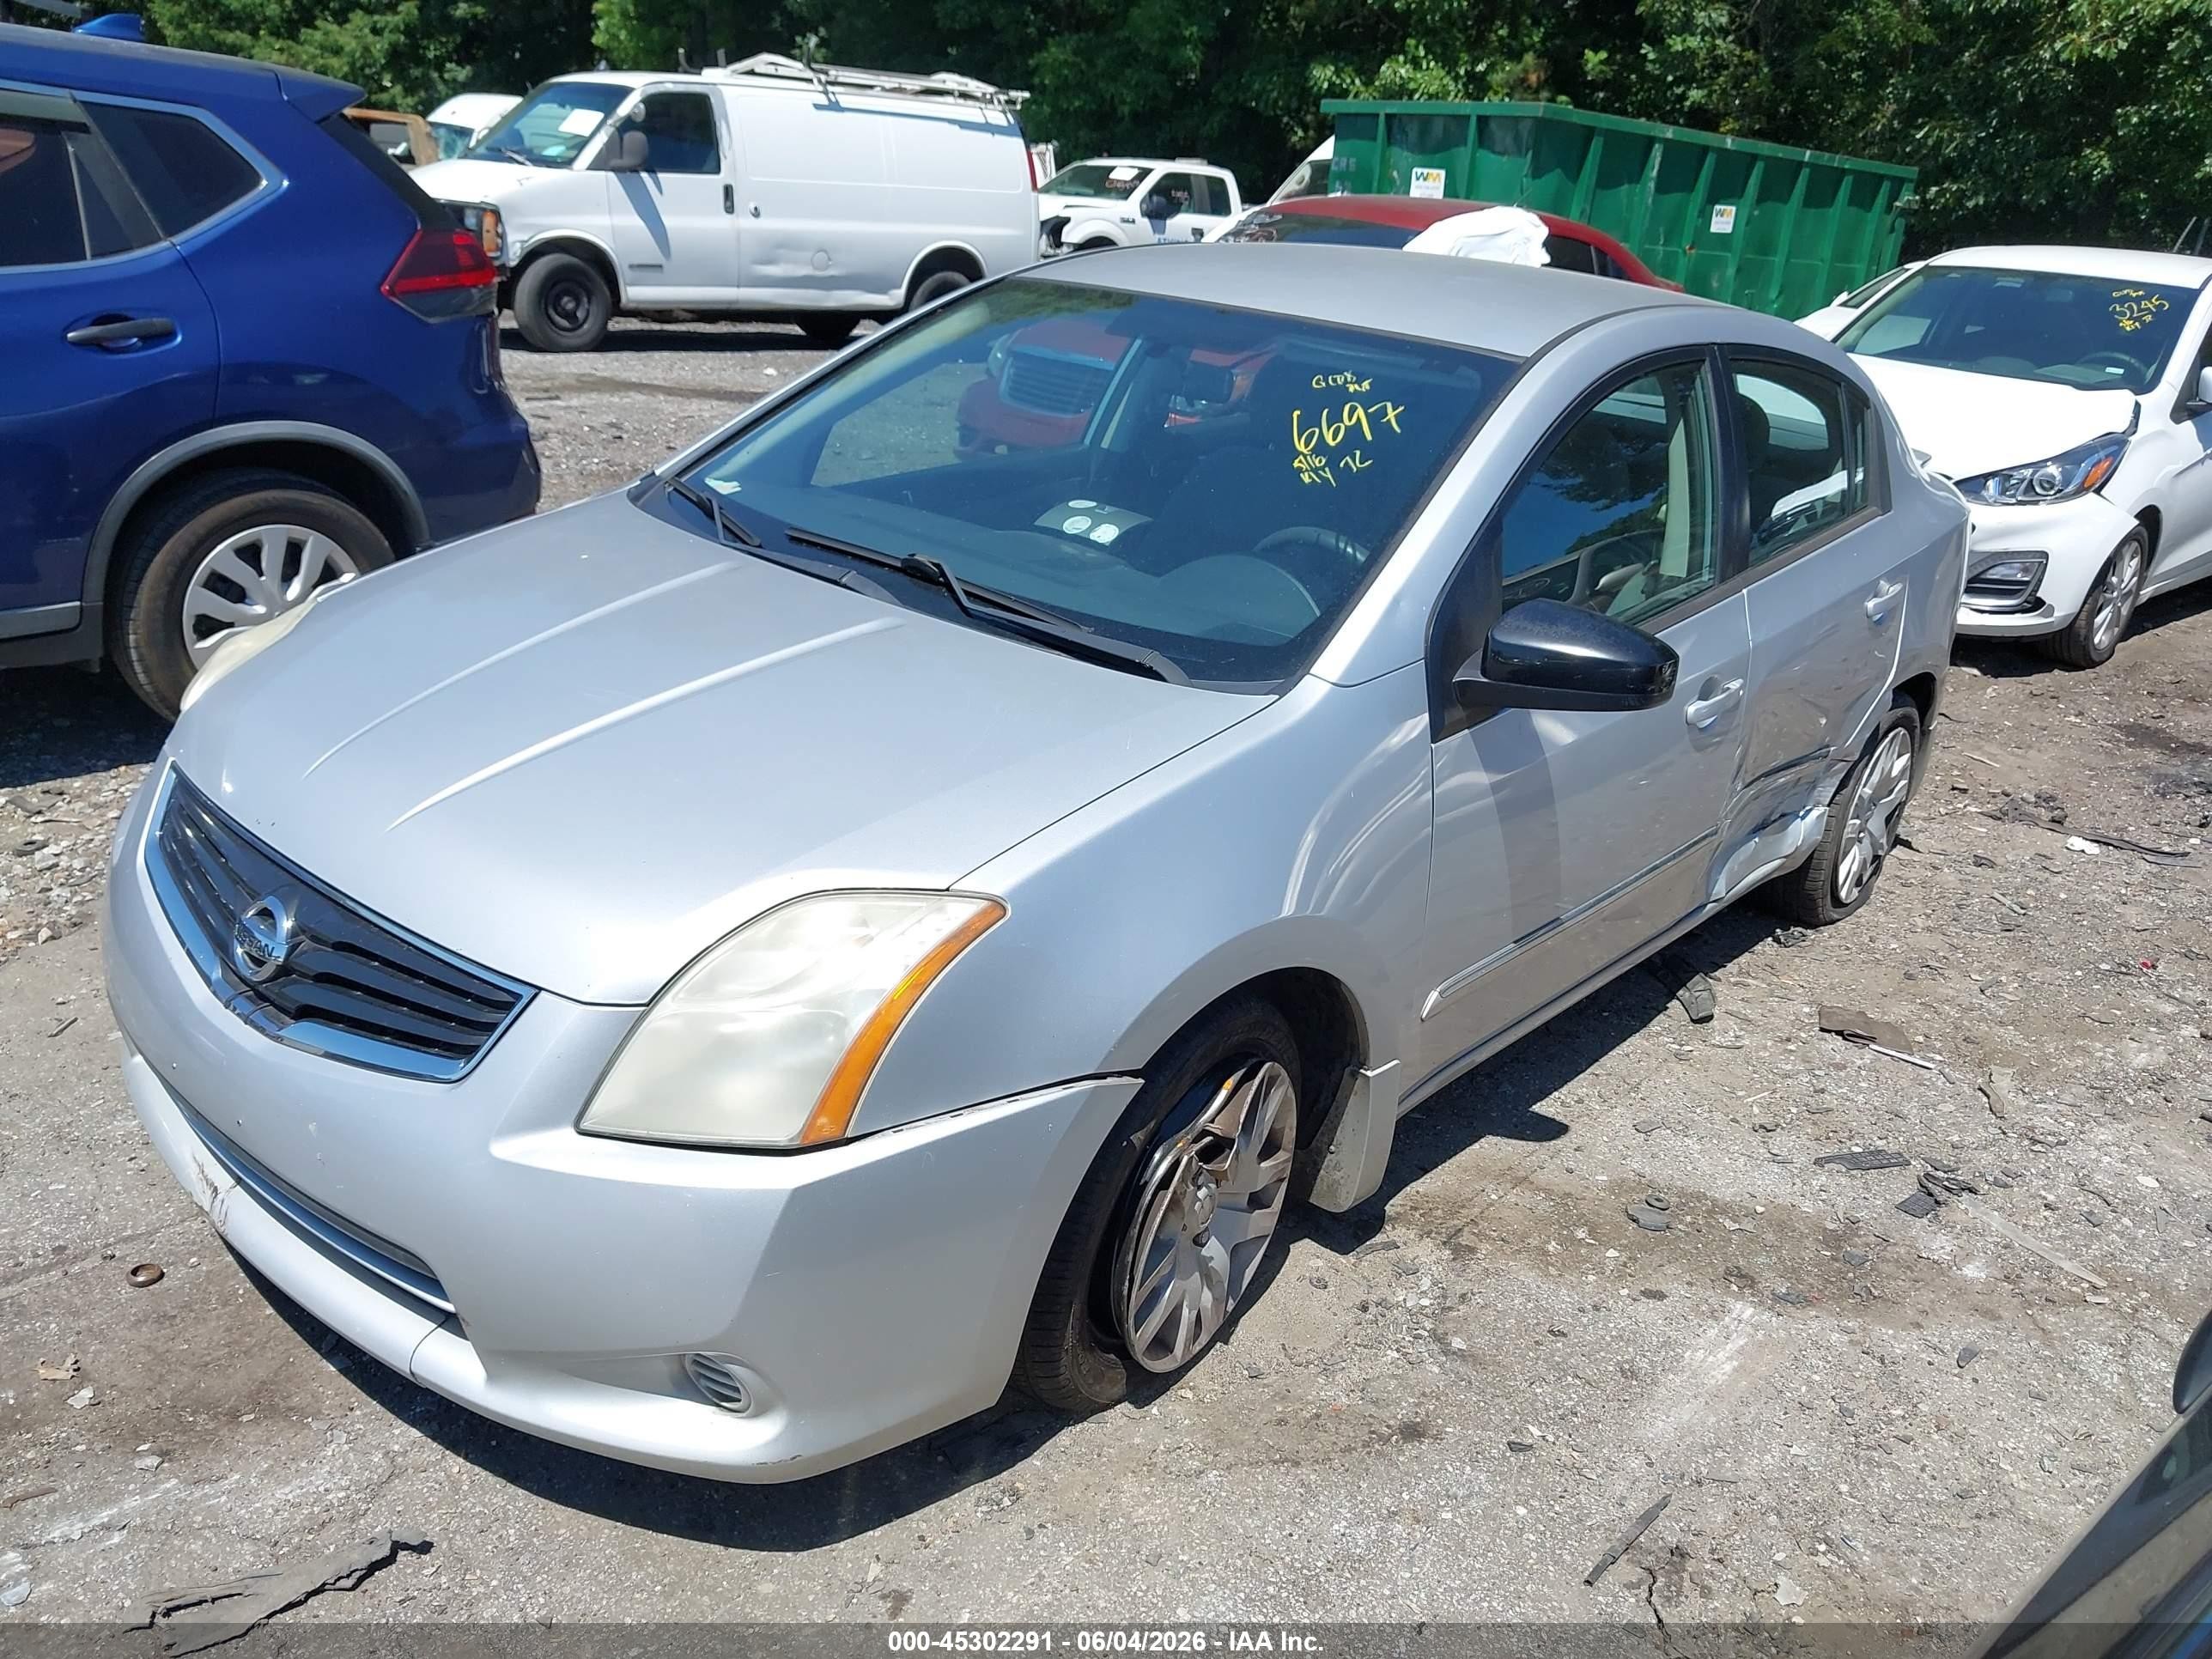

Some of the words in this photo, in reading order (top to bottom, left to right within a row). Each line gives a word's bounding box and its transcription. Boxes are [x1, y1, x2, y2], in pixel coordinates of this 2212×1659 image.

[1415, 171, 1442, 183] WM
[1715, 207, 1733, 218] WM
[2109, 294, 2170, 319] 3245
[1292, 401, 1406, 454] 6697
